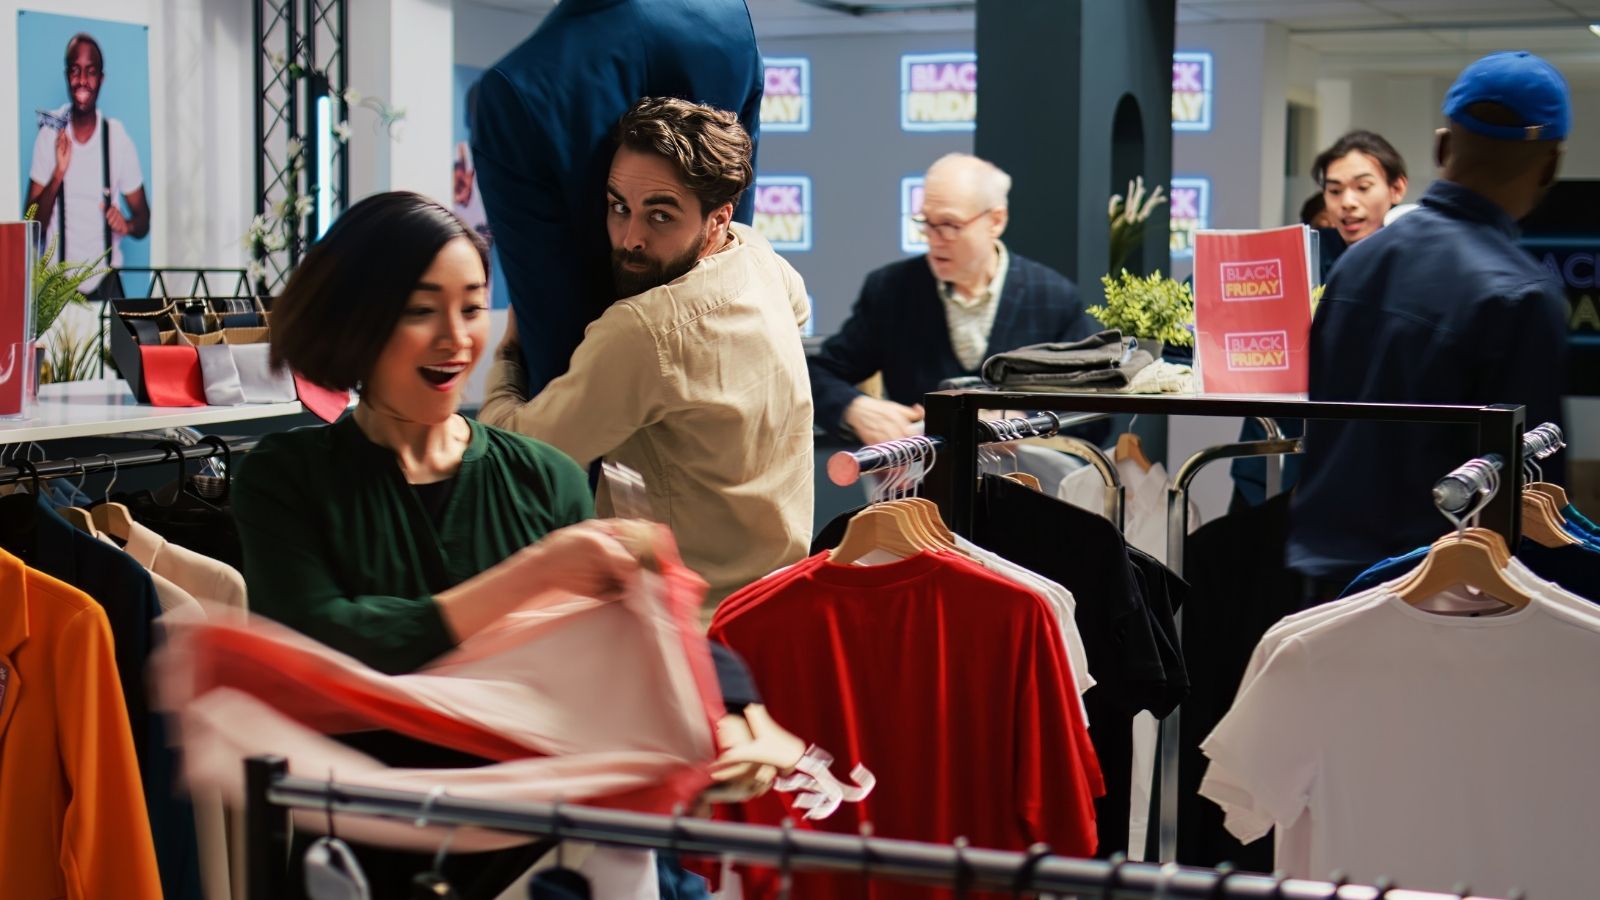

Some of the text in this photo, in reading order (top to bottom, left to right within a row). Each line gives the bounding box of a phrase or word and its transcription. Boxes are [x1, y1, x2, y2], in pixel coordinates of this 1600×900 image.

[1226, 264, 1277, 281] BLACK
[1225, 279, 1280, 297] FRIDAY
[1231, 336, 1281, 353] BLACK
[1231, 351, 1284, 367] FRIDAY
